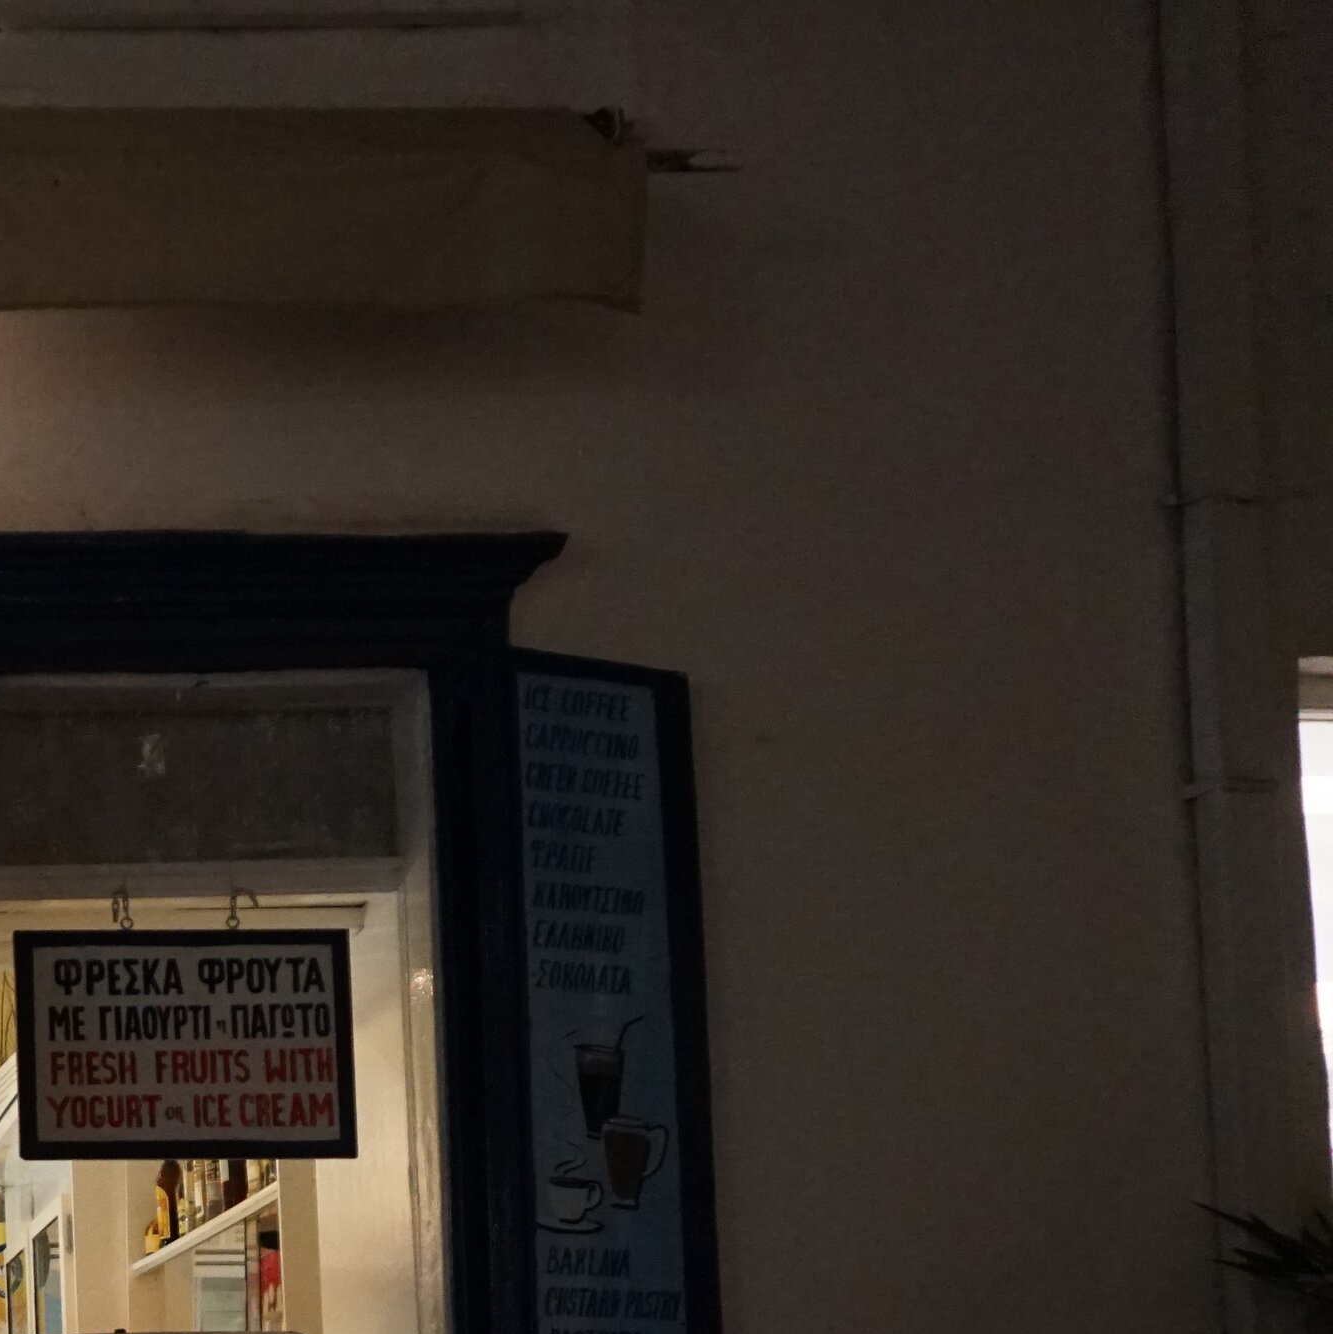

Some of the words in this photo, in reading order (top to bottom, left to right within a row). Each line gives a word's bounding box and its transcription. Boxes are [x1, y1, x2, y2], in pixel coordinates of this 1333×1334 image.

[525, 683, 553, 713] ICE
[561, 688, 632, 721] COFFEE
[526, 722, 640, 761] CAPPUCCINO
[582, 767, 645, 801] COFFEE
[528, 800, 627, 837] CHOCOLATE
[531, 840, 597, 874] ΦΡΑΠΕ
[54, 957, 184, 997] ΦΡΕΣΚΑ
[198, 956, 327, 994] ΦΡΟΥΤΑ
[535, 958, 632, 995] ΣΟΚΟΛΑΤΑ
[48, 1004, 85, 1042] ΜΕ
[98, 1004, 211, 1041] ΓΙΑΟΥΡΤΙ
[230, 1002, 331, 1039] ΠΑΓΩΤΟ
[50, 1050, 137, 1086] FRESH
[154, 1048, 250, 1084] FRUITS
[263, 1047, 334, 1083] WITH
[46, 1094, 162, 1129] YOGURT
[193, 1093, 232, 1128] ICE
[239, 1092, 335, 1128] CREAM
[546, 1247, 631, 1277] BAKLAVA
[545, 1286, 619, 1318] CUSTARD
[624, 1290, 682, 1321] PASTRY
